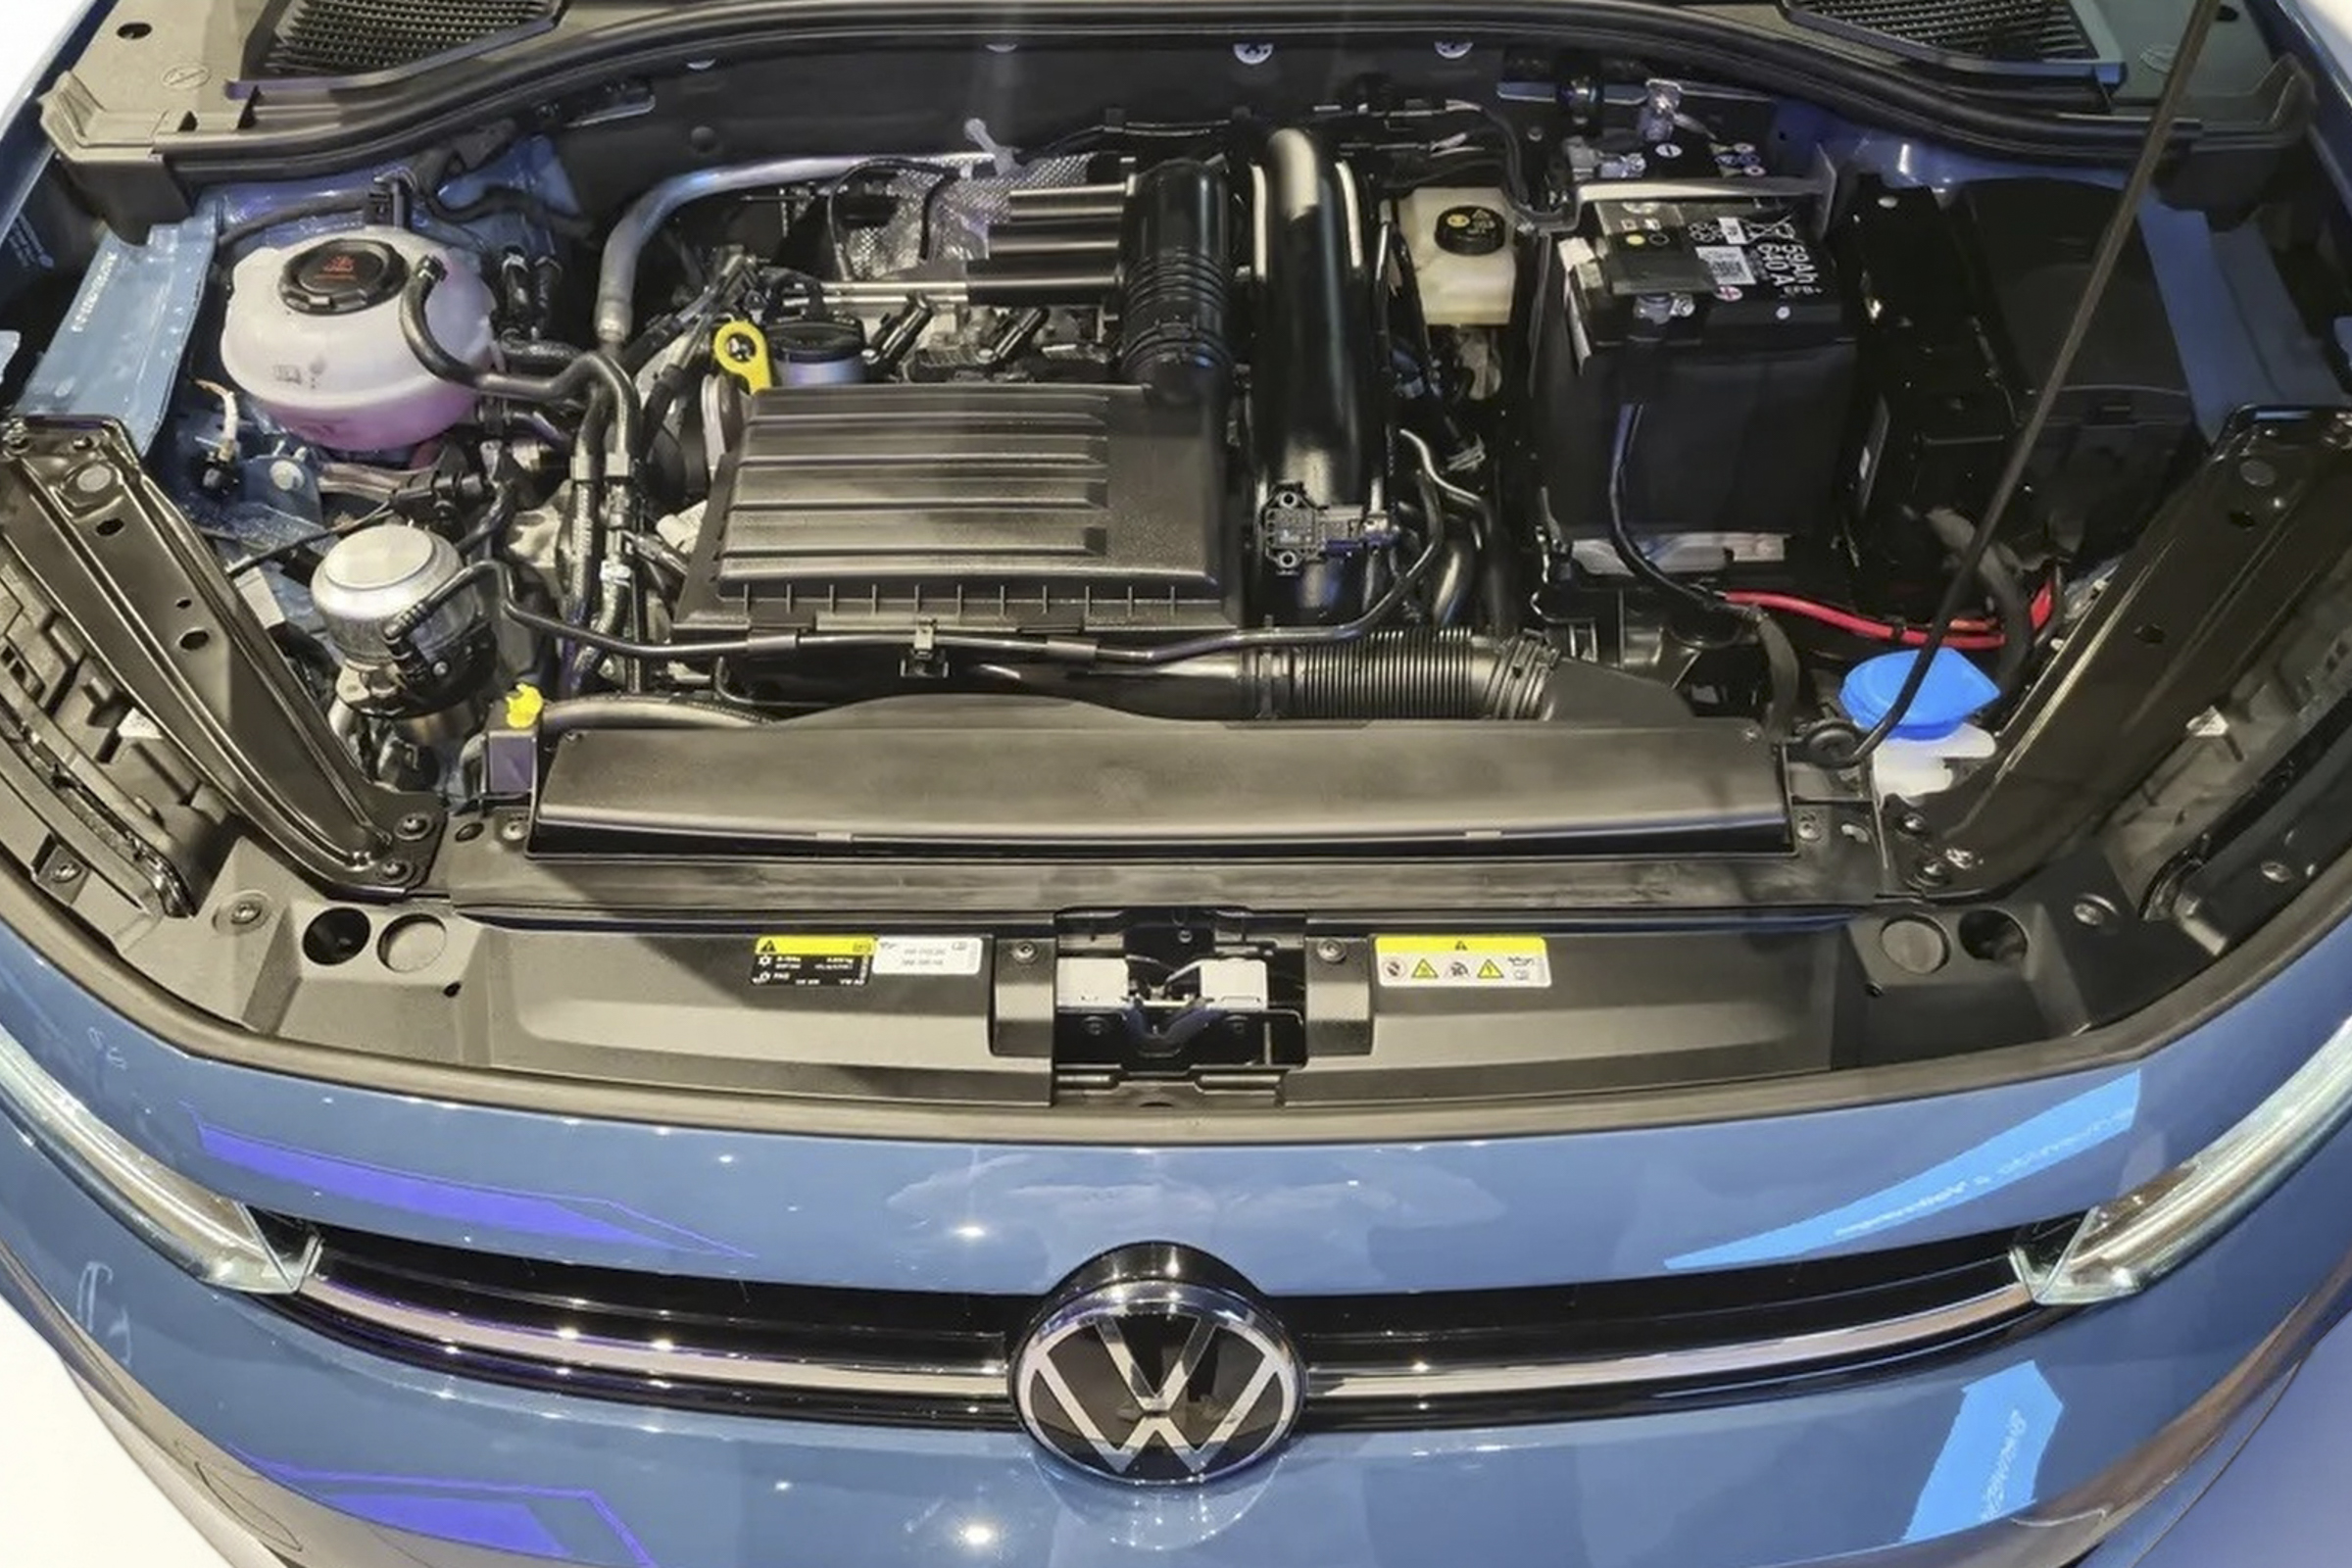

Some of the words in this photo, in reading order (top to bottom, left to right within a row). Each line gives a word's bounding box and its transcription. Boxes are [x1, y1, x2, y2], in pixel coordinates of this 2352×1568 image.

[1757, 243, 1789, 270] 640
[1781, 243, 1819, 283] 59Ah
[1770, 273, 1795, 287] A
